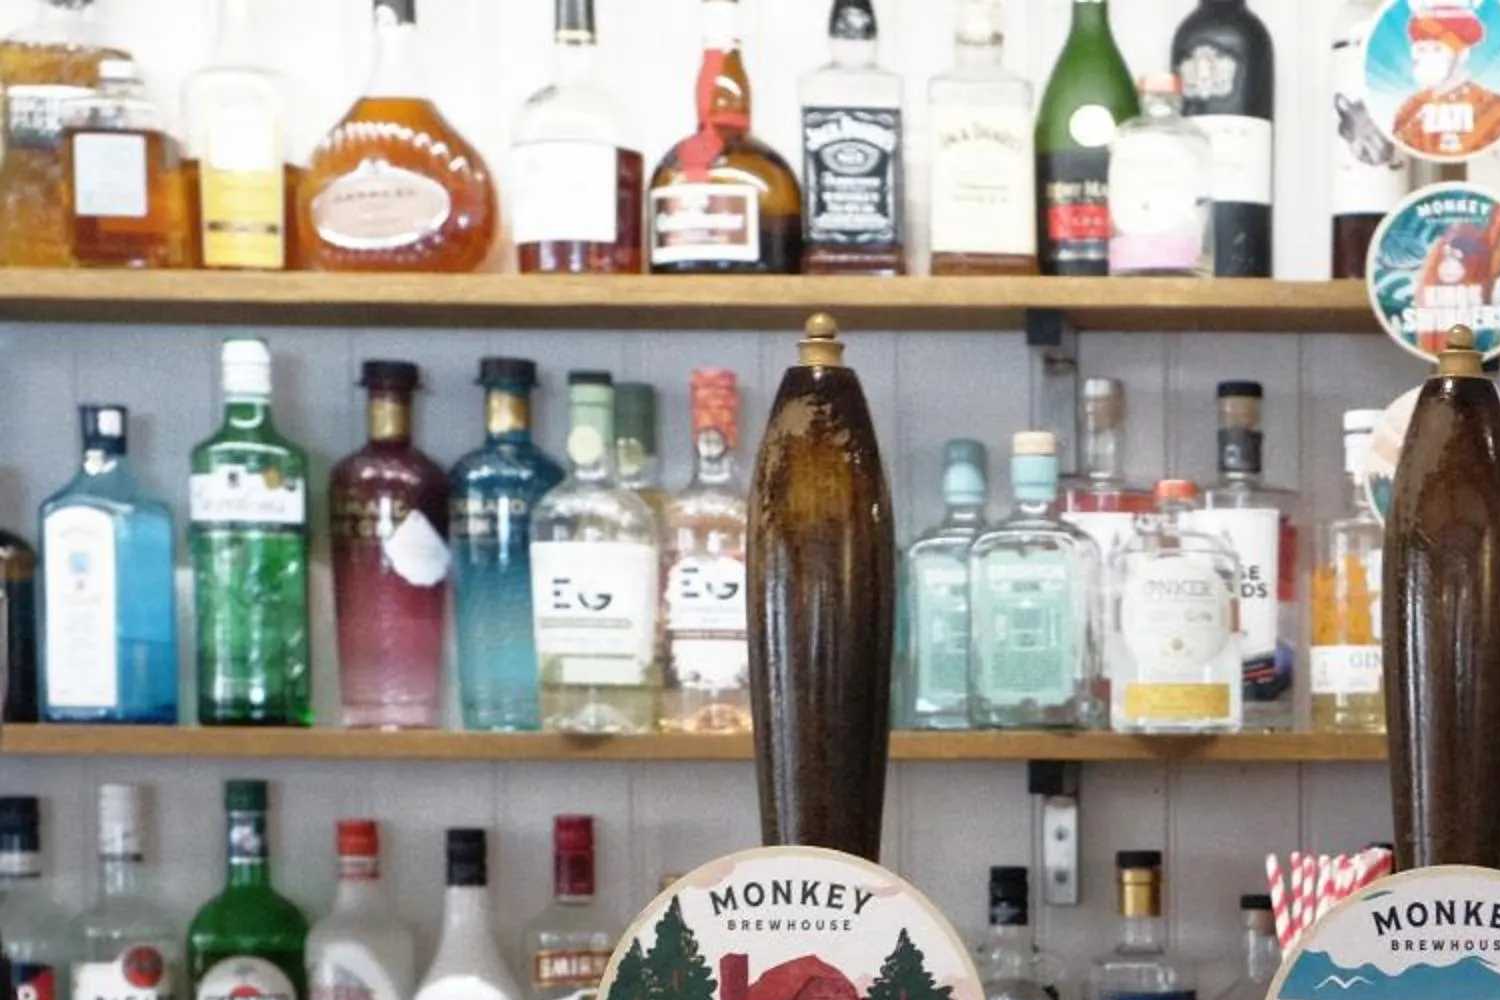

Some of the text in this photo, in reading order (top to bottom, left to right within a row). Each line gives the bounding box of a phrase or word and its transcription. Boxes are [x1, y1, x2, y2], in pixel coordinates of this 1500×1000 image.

[1416, 199, 1492, 217] MONKEY
[709, 880, 875, 916] MONKEY
[727, 919, 853, 931] BREWHOUSE
